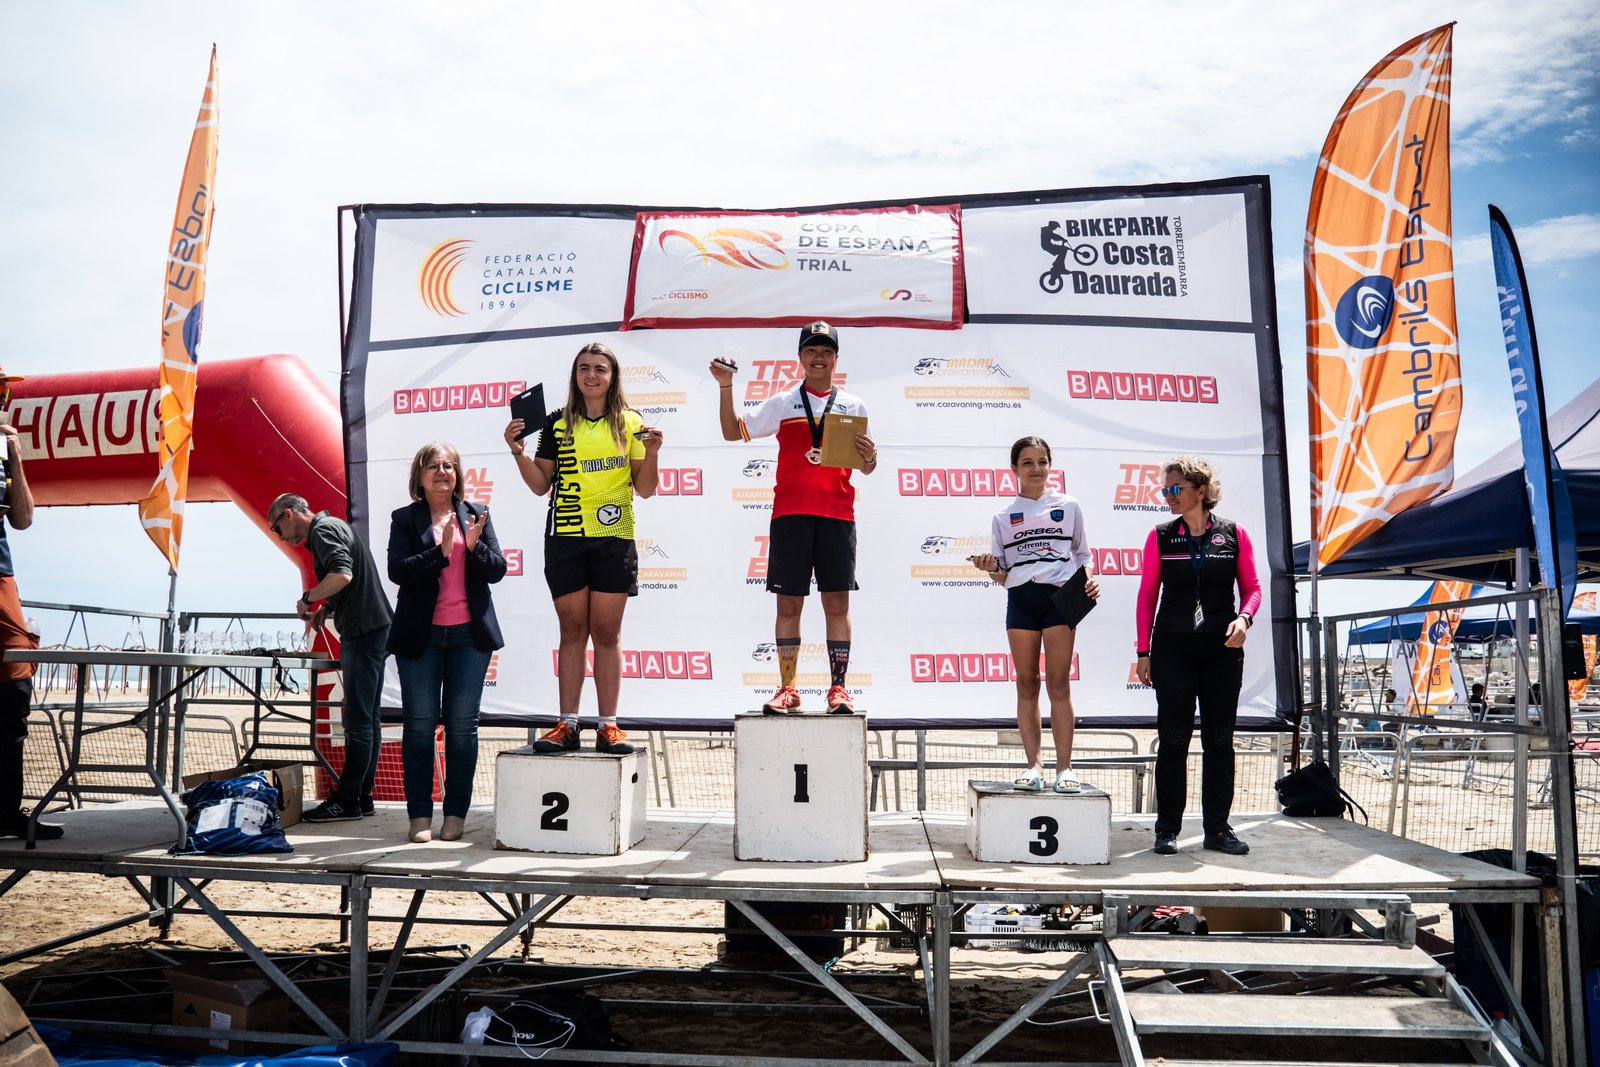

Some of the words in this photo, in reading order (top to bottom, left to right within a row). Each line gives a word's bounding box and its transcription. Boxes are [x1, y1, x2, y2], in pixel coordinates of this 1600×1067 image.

[1066, 216, 1171, 237] BIKEPARK
[798, 236, 829, 248] DE
[838, 235, 933, 253] ESPAÑA
[1103, 242, 1175, 266] Costa
[485, 252, 576, 264] FEDERACIÓ
[797, 258, 852, 272] TRIAL
[1174, 216, 1188, 297] TORREDEMBARRA
[483, 266, 575, 279] CATALANA
[482, 279, 573, 295] CICLISME
[1072, 271, 1178, 297] Daurada
[480, 300, 516, 310] 1896
[668, 292, 709, 300] CICLISMO
[1398, 279, 1432, 462] Cambrils
[1070, 374, 1216, 399] BAUHAUS
[915, 401, 1021, 409] www.caravaning-madru.es
[901, 472, 1062, 493] BAUHAS
[1013, 527, 1063, 540] ORBEA
[793, 763, 809, 803] 1
[540, 792, 569, 831] 2
[1029, 816, 1059, 857] 3
